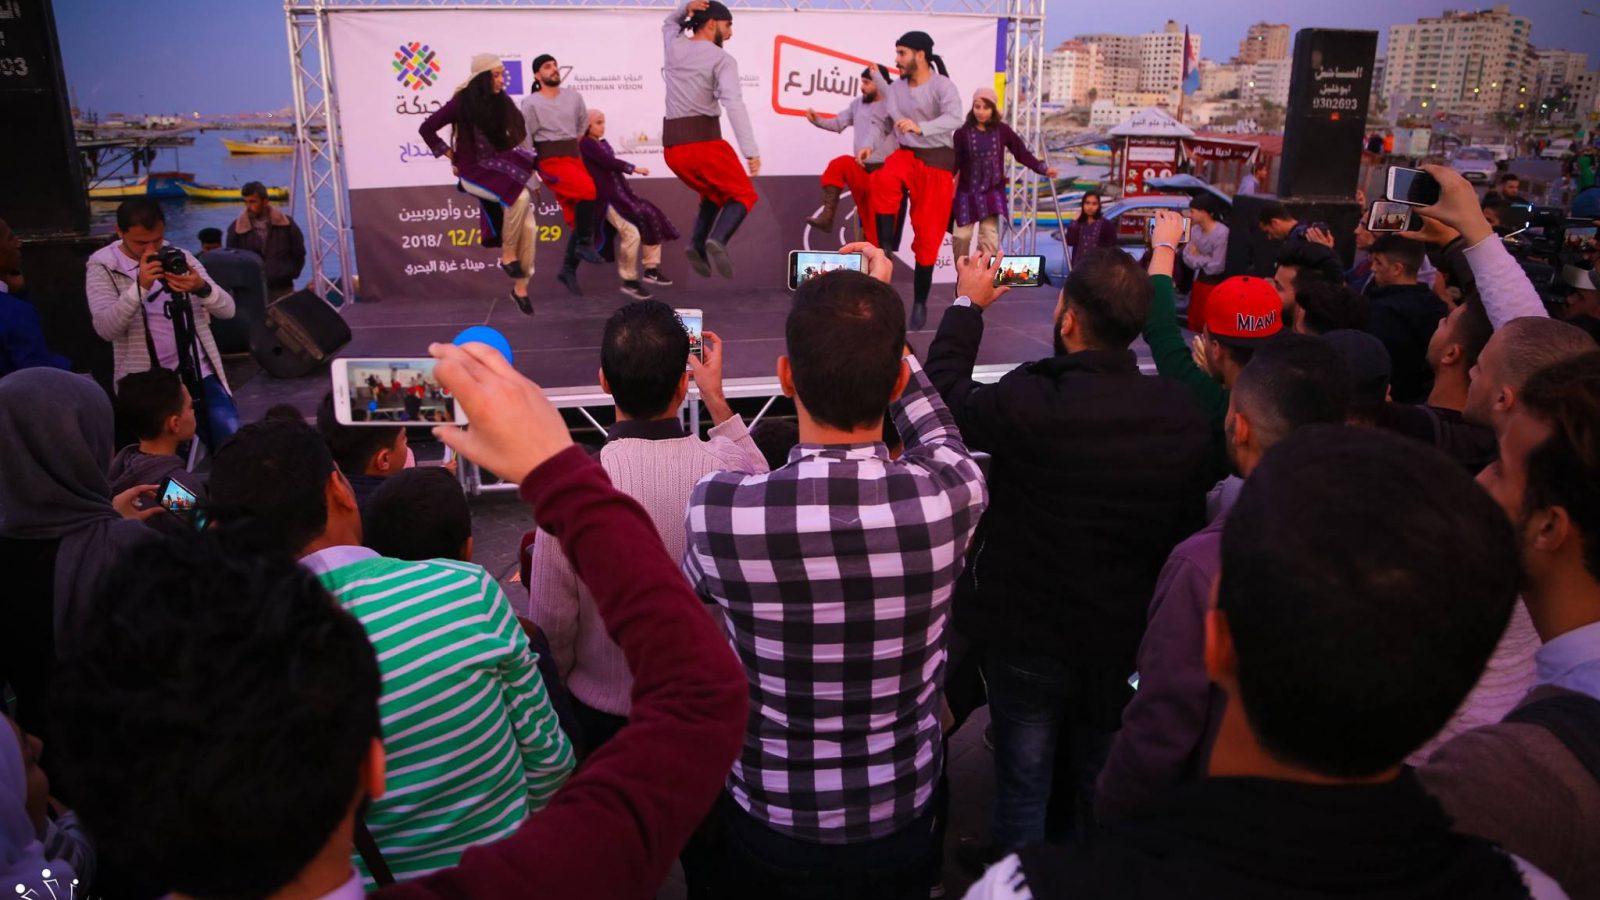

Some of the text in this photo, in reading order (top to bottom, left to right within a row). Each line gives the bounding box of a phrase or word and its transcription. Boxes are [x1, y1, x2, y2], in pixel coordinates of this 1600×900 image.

[784, 66, 858, 97] الشارع
[398, 198, 461, 222] وأوروبيين
[404, 260, 437, 276] البحري
[439, 259, 458, 273] غزة
[460, 258, 485, 272] ميناء
[1236, 309, 1276, 331] MIAMI
